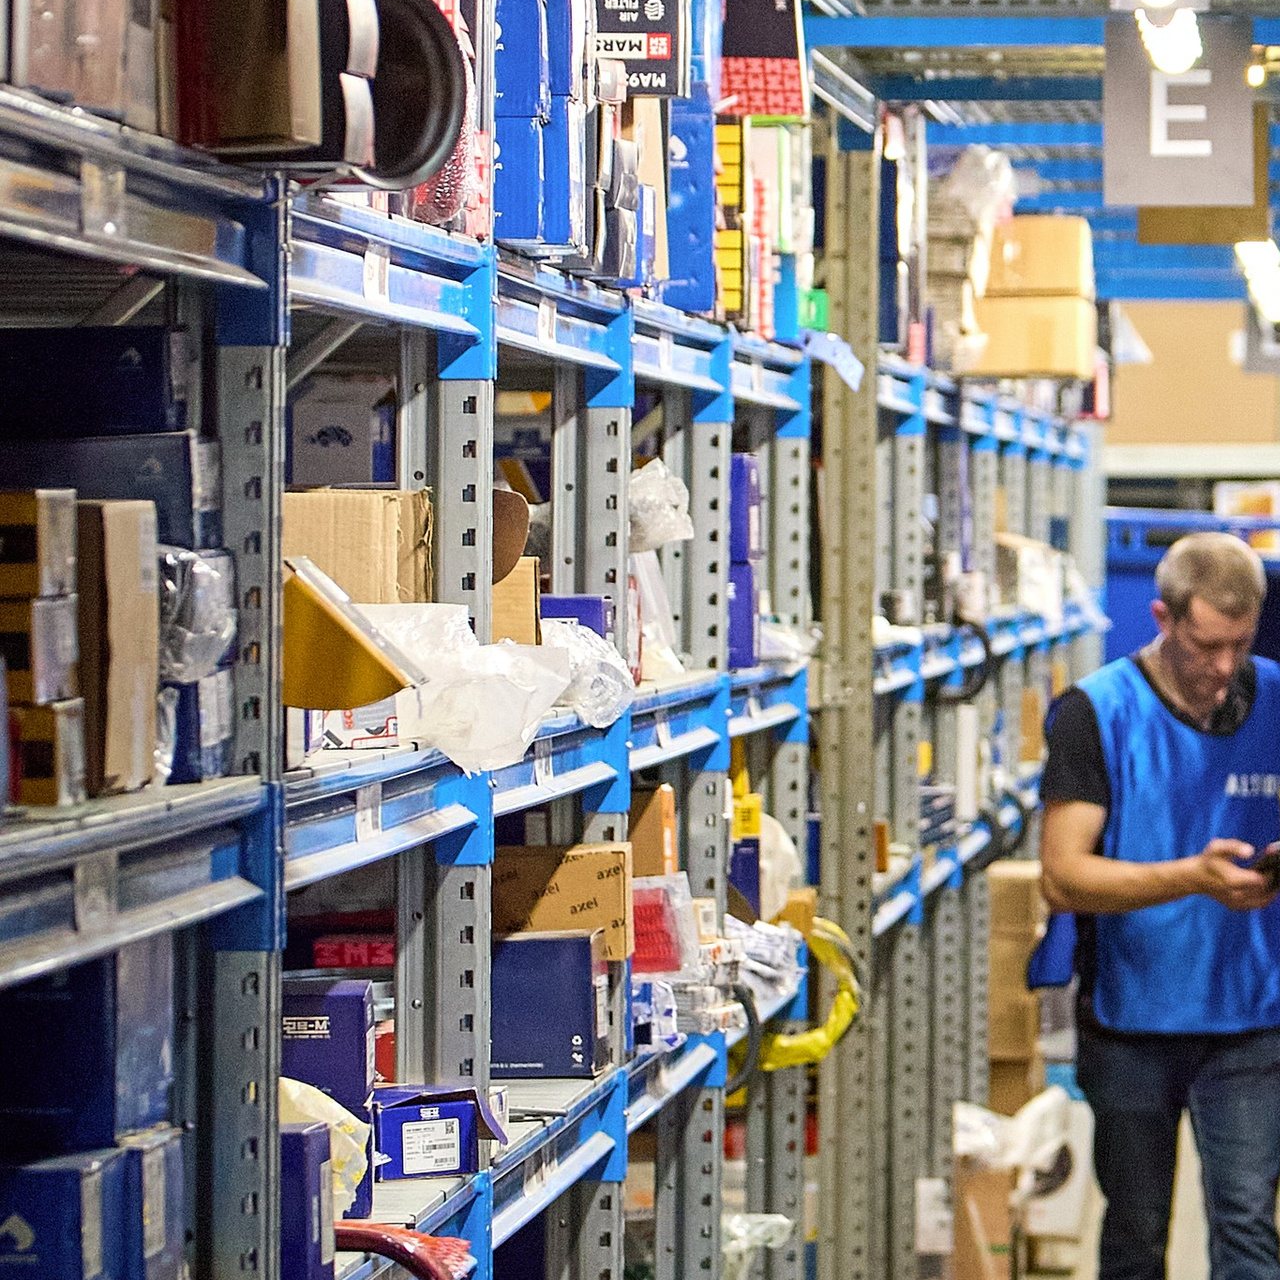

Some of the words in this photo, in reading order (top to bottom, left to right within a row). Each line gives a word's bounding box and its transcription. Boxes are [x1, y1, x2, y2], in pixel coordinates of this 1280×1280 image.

[604, 0, 639, 9] FILTER
[619, 12, 639, 22] AIR
[1150, 69, 1212, 157] E
[569, 897, 598, 915] axel
